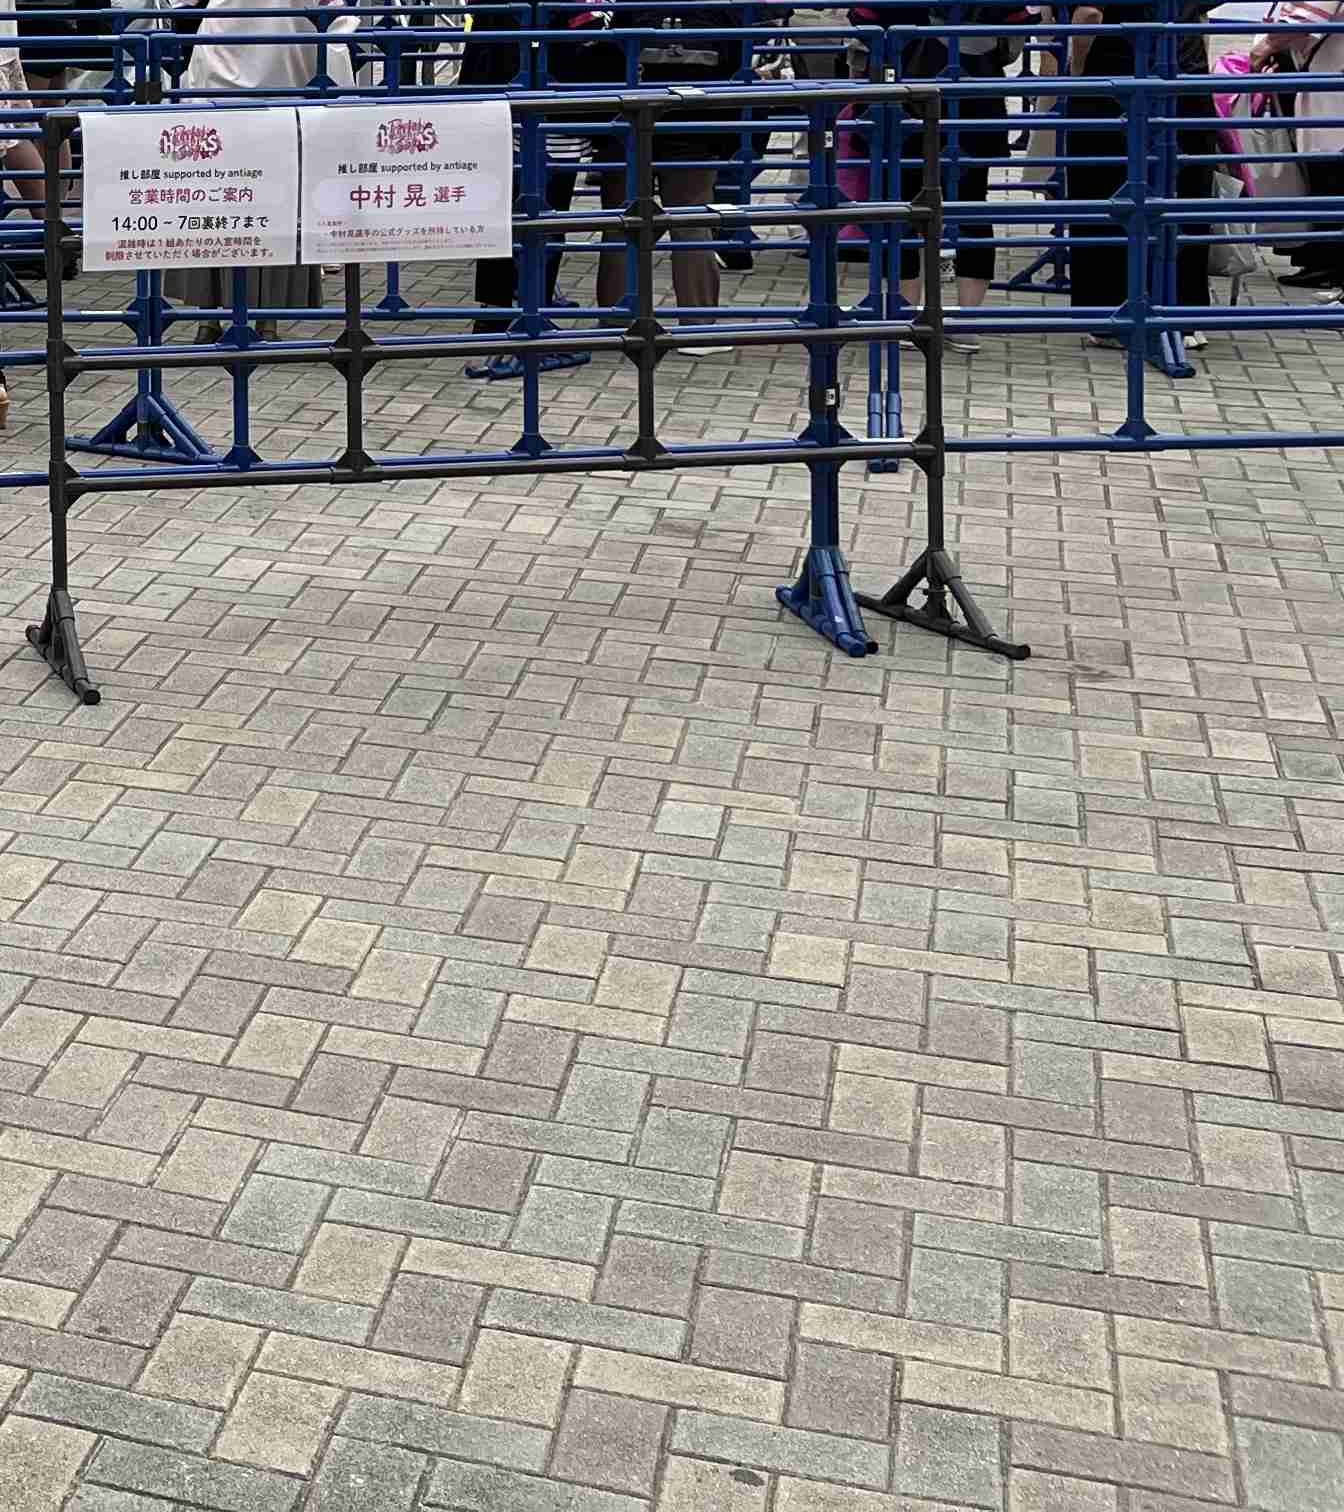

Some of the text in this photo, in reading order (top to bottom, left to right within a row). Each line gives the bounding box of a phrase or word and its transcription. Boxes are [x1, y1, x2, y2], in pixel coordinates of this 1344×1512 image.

[163, 168, 212, 180] supported
[214, 168, 226, 180] by
[227, 168, 263, 179] antiage
[381, 162, 428, 174] supported
[431, 162, 442, 174] by
[443, 161, 478, 172] antiage
[128, 188, 253, 205] 営業時間のご案内
[350, 184, 466, 210] 中村 晃 選手
[112, 215, 158, 232] 14:00
